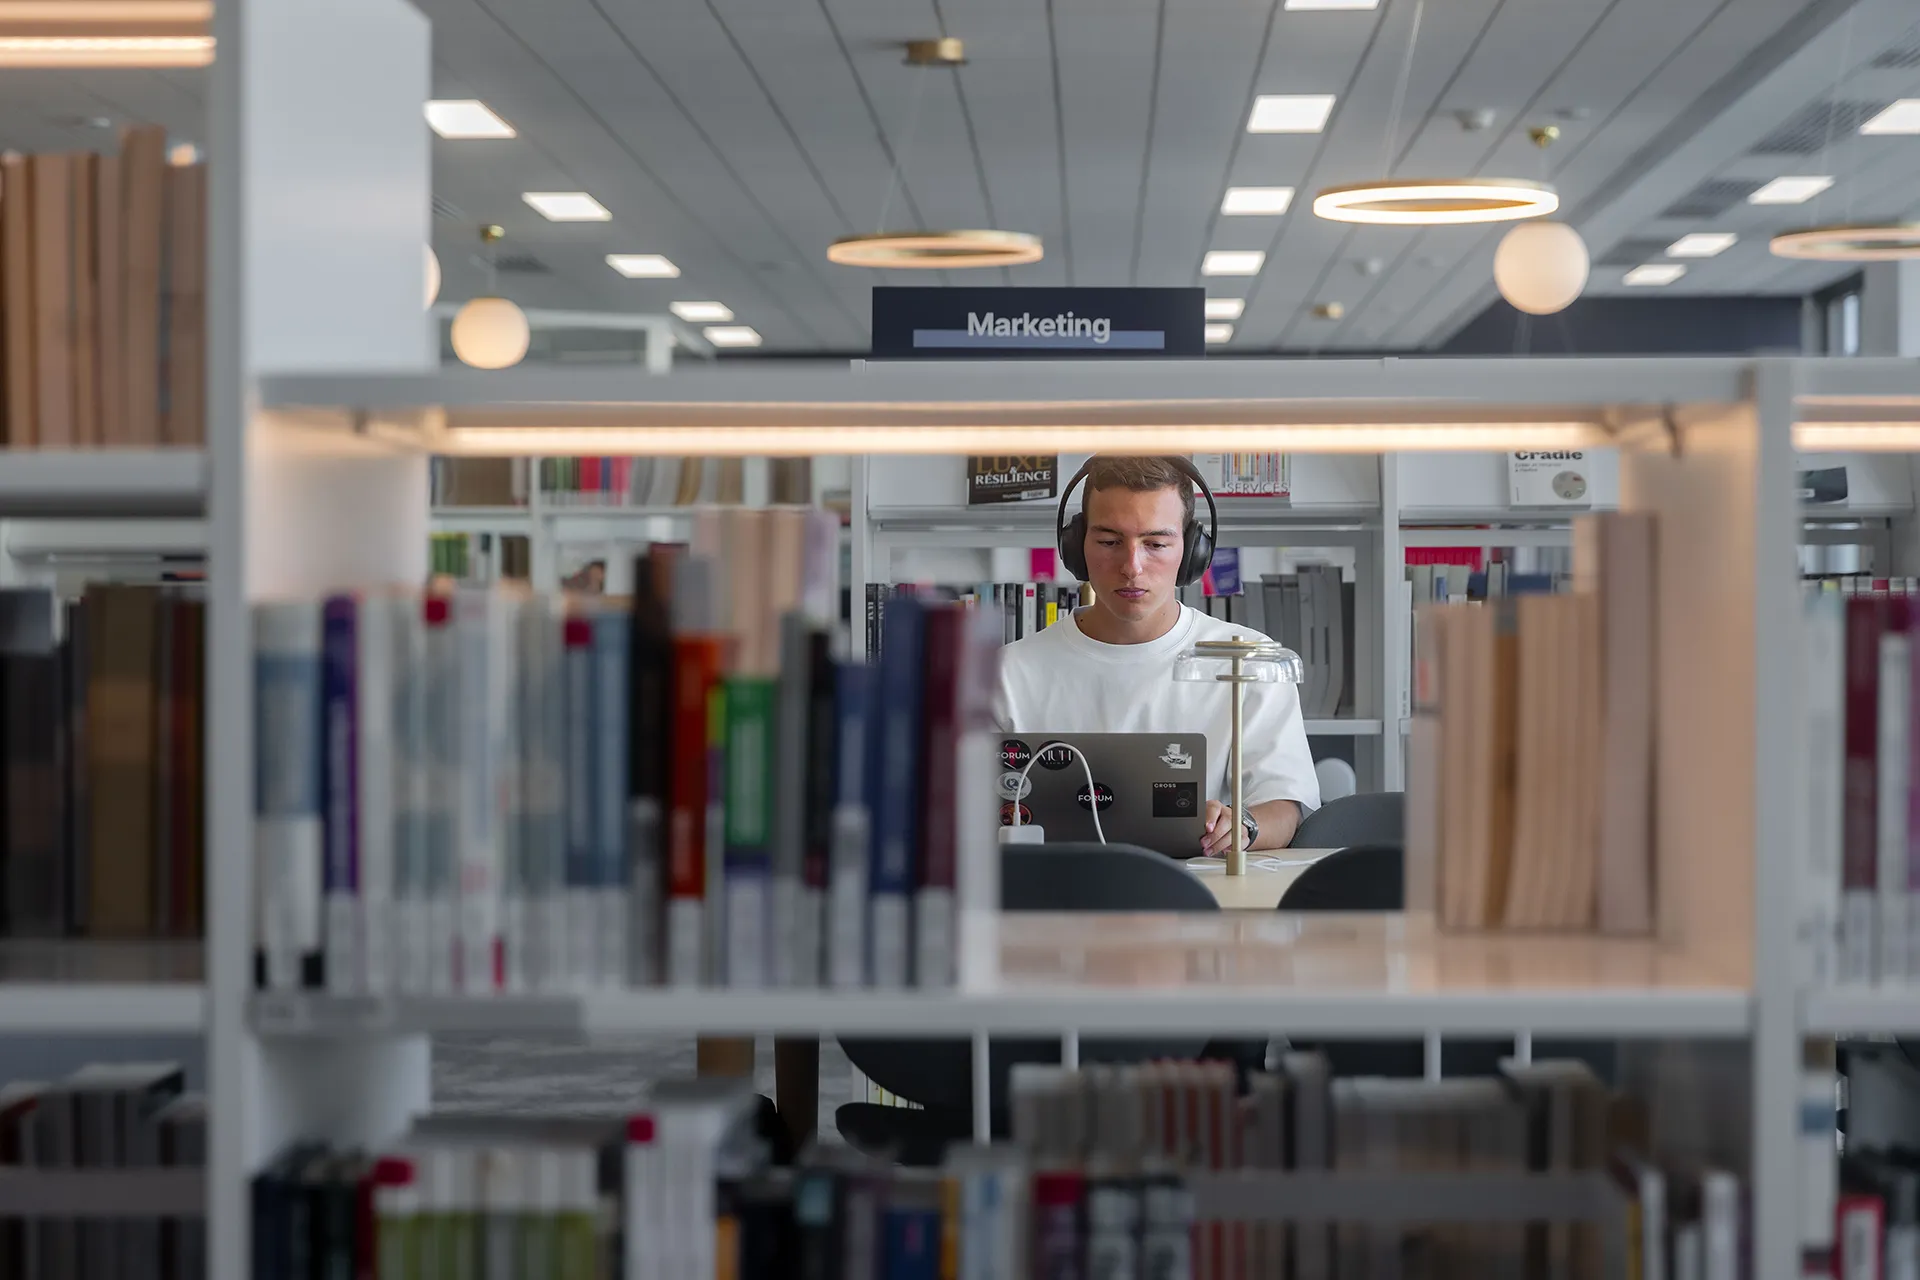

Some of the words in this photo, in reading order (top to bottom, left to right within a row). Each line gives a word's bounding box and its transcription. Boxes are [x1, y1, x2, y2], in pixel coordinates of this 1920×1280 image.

[968, 311, 1111, 343] Marketing
[976, 454, 1052, 475] LUXE
[975, 468, 1052, 486] RÉSILIENCE
[1227, 482, 1289, 494] SERVICES
